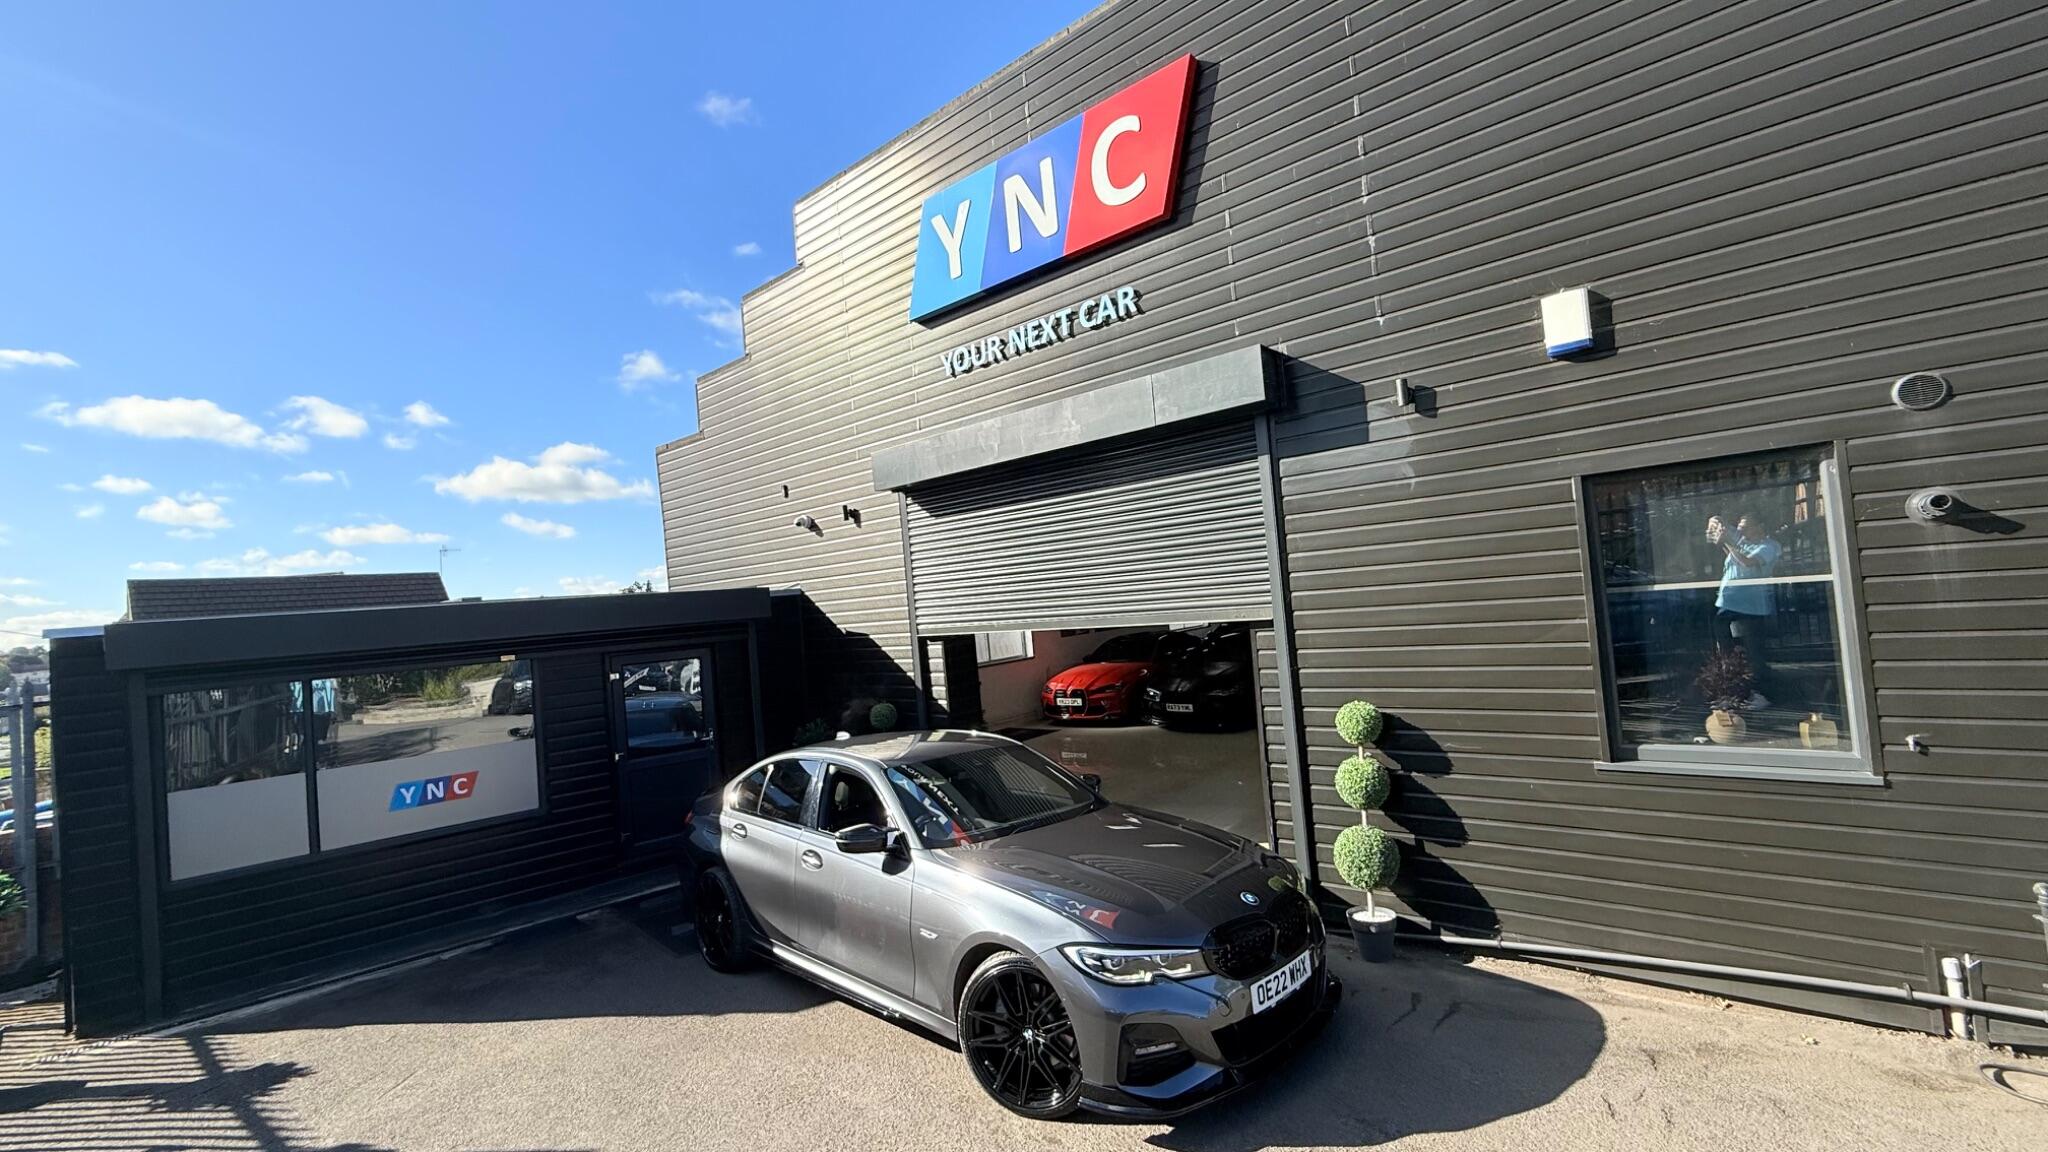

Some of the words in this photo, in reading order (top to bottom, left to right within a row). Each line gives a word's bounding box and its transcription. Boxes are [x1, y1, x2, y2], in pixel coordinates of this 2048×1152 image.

[931, 114, 1146, 279] YNC
[940, 335, 1003, 376] YOUR
[1008, 307, 1073, 354] NEXT
[1079, 285, 1138, 328] CAR
[400, 777, 468, 804] YNC
[1256, 970, 1288, 1005] OE22
[1288, 955, 1307, 985] WHX
